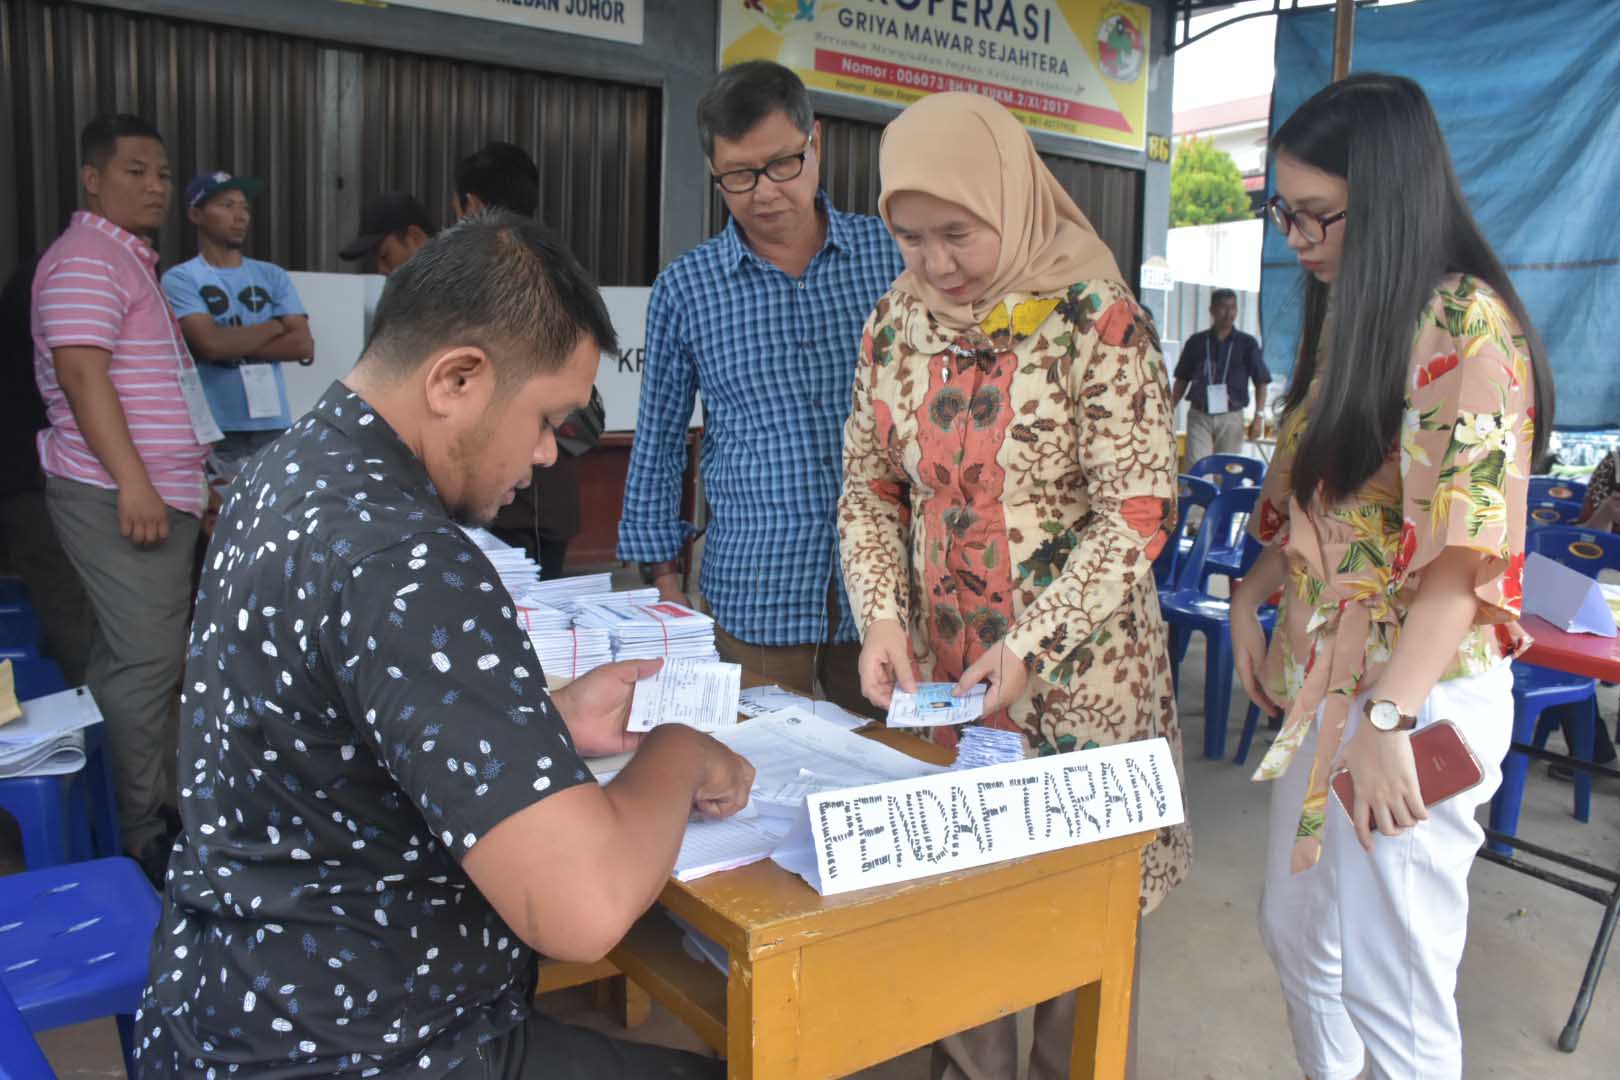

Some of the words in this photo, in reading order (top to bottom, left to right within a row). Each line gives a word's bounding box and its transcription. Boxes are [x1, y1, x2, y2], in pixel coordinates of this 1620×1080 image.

[565, 0, 625, 24] JOHOR
[866, 0, 1051, 43] PERASI
[838, 8, 898, 39] GRIYA
[904, 21, 972, 55] MAWAR
[978, 40, 1069, 77] SEJAHTERA
[841, 57, 887, 79] Nomor
[819, 754, 1166, 880] PENDAFTARAN
